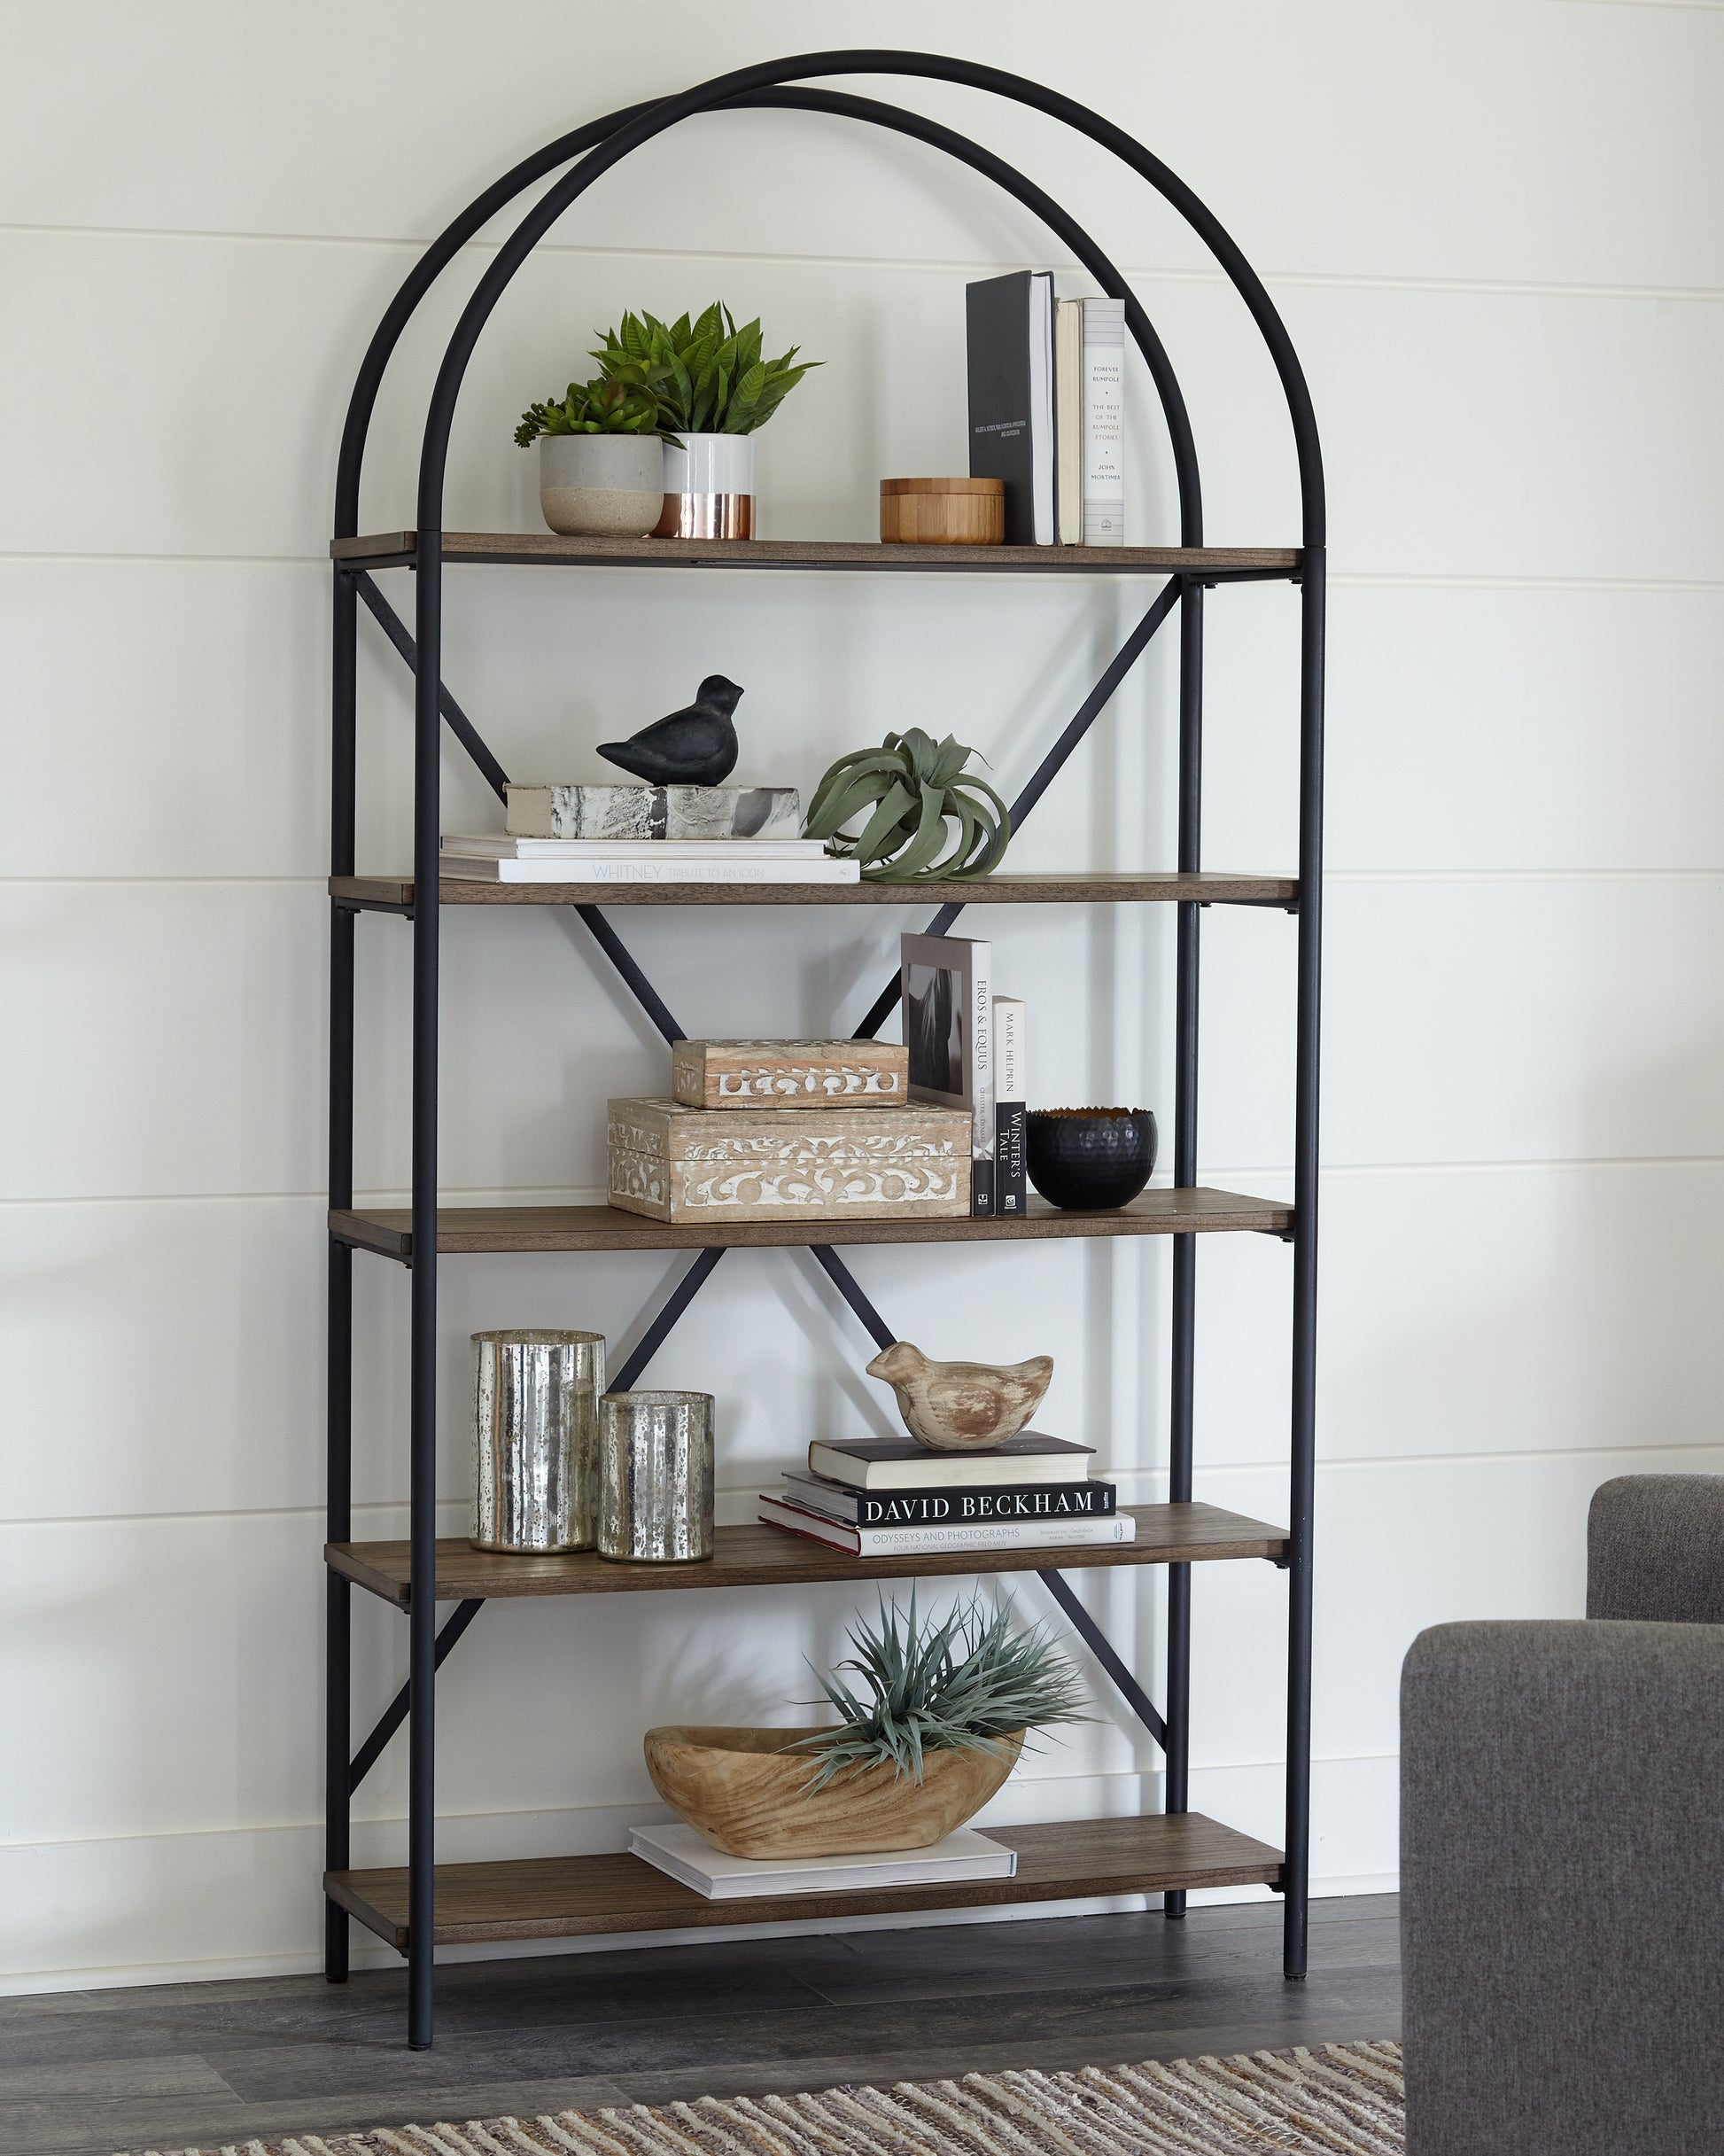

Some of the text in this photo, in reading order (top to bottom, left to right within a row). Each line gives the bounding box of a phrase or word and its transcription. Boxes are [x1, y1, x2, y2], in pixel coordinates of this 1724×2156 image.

[593, 864, 663, 879] WHITNEY
[668, 868, 704, 878] TRIBUTE
[708, 868, 720, 878] TO
[722, 868, 736, 878] AN
[975, 980, 988, 1070] EROS & EQUUS
[1006, 1012, 1014, 1092] MARK HELPRIN
[999, 1129, 1010, 1161] TALE
[1011, 1111, 1022, 1178] WINTER'S
[865, 1498, 950, 1522] DAVID
[961, 1491, 1093, 1517] BECKHAM
[873, 1528, 1021, 1545] ODYSSEYS AND PHOTOGRAPHS
